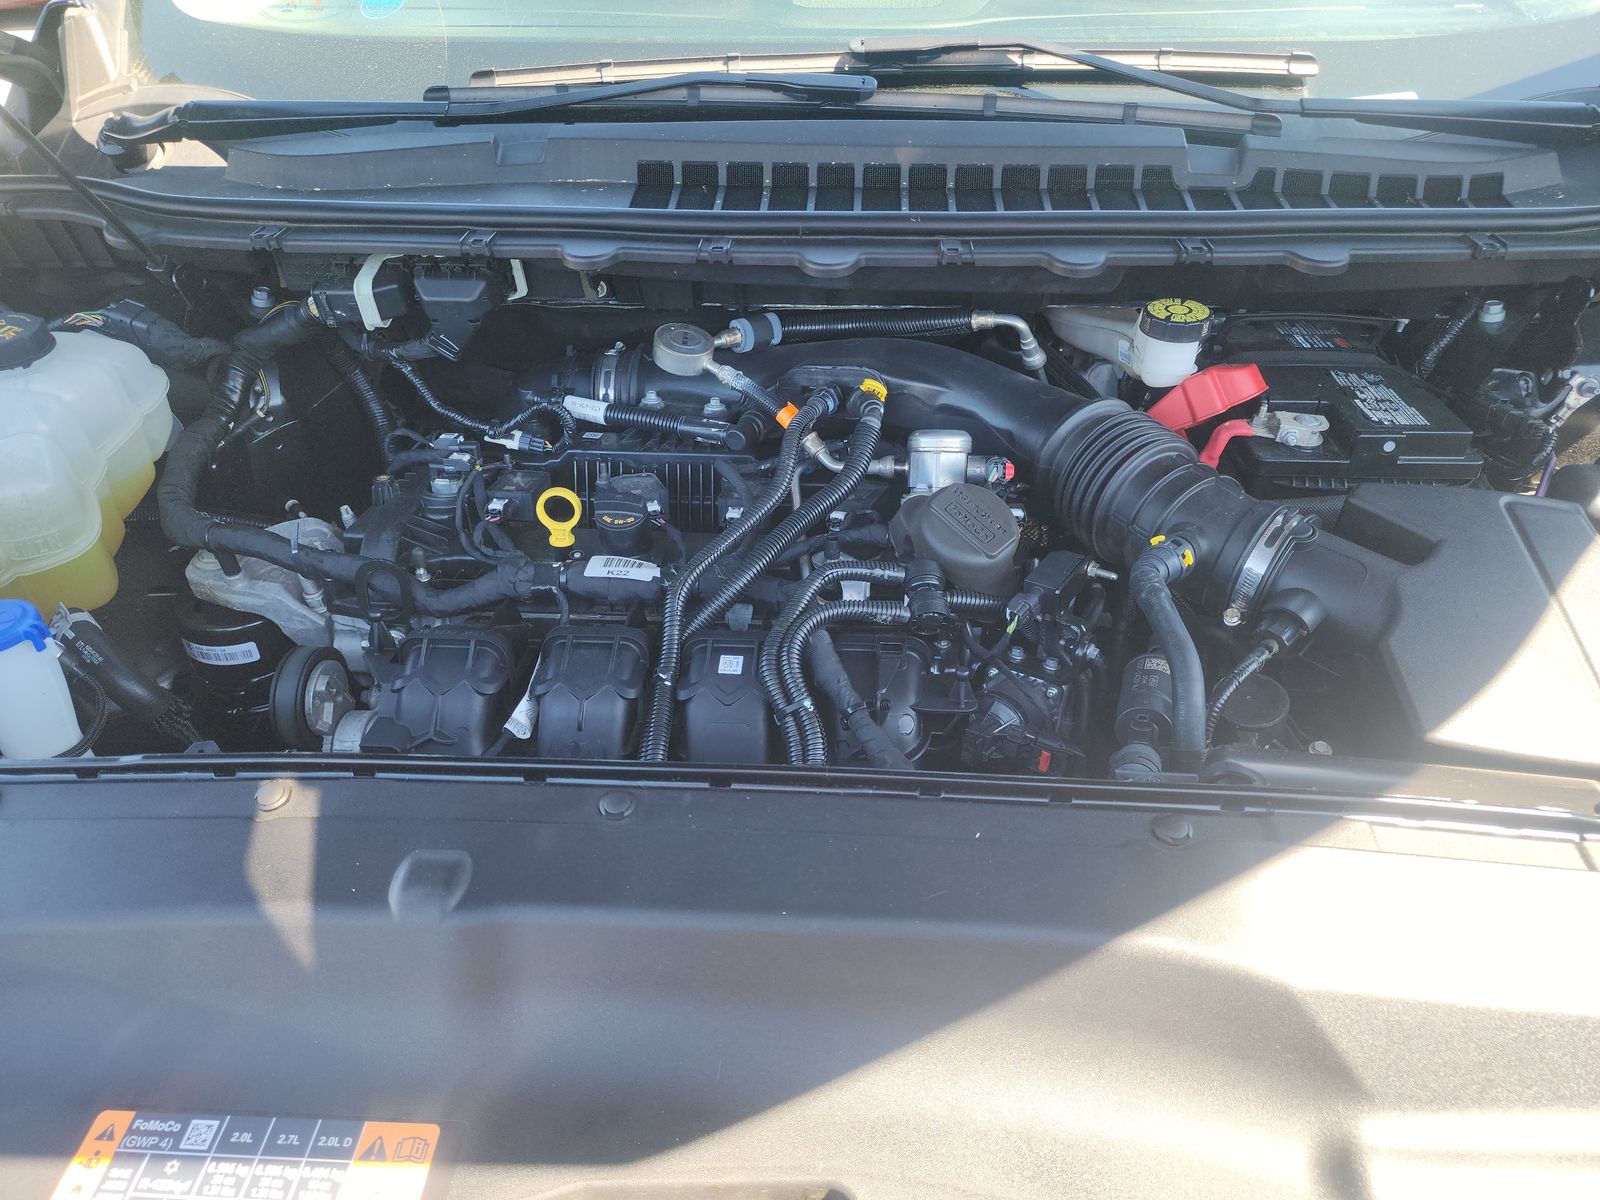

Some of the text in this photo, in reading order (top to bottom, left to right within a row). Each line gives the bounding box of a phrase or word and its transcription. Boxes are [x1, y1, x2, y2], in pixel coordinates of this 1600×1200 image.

[132, 1119, 181, 1132] FoMoCo
[121, 1135, 174, 1150] (GWP 4)
[230, 1132, 253, 1143] 2.0L
[276, 1134, 300, 1145] 2.7L
[317, 1136, 353, 1147] 2.0L D
